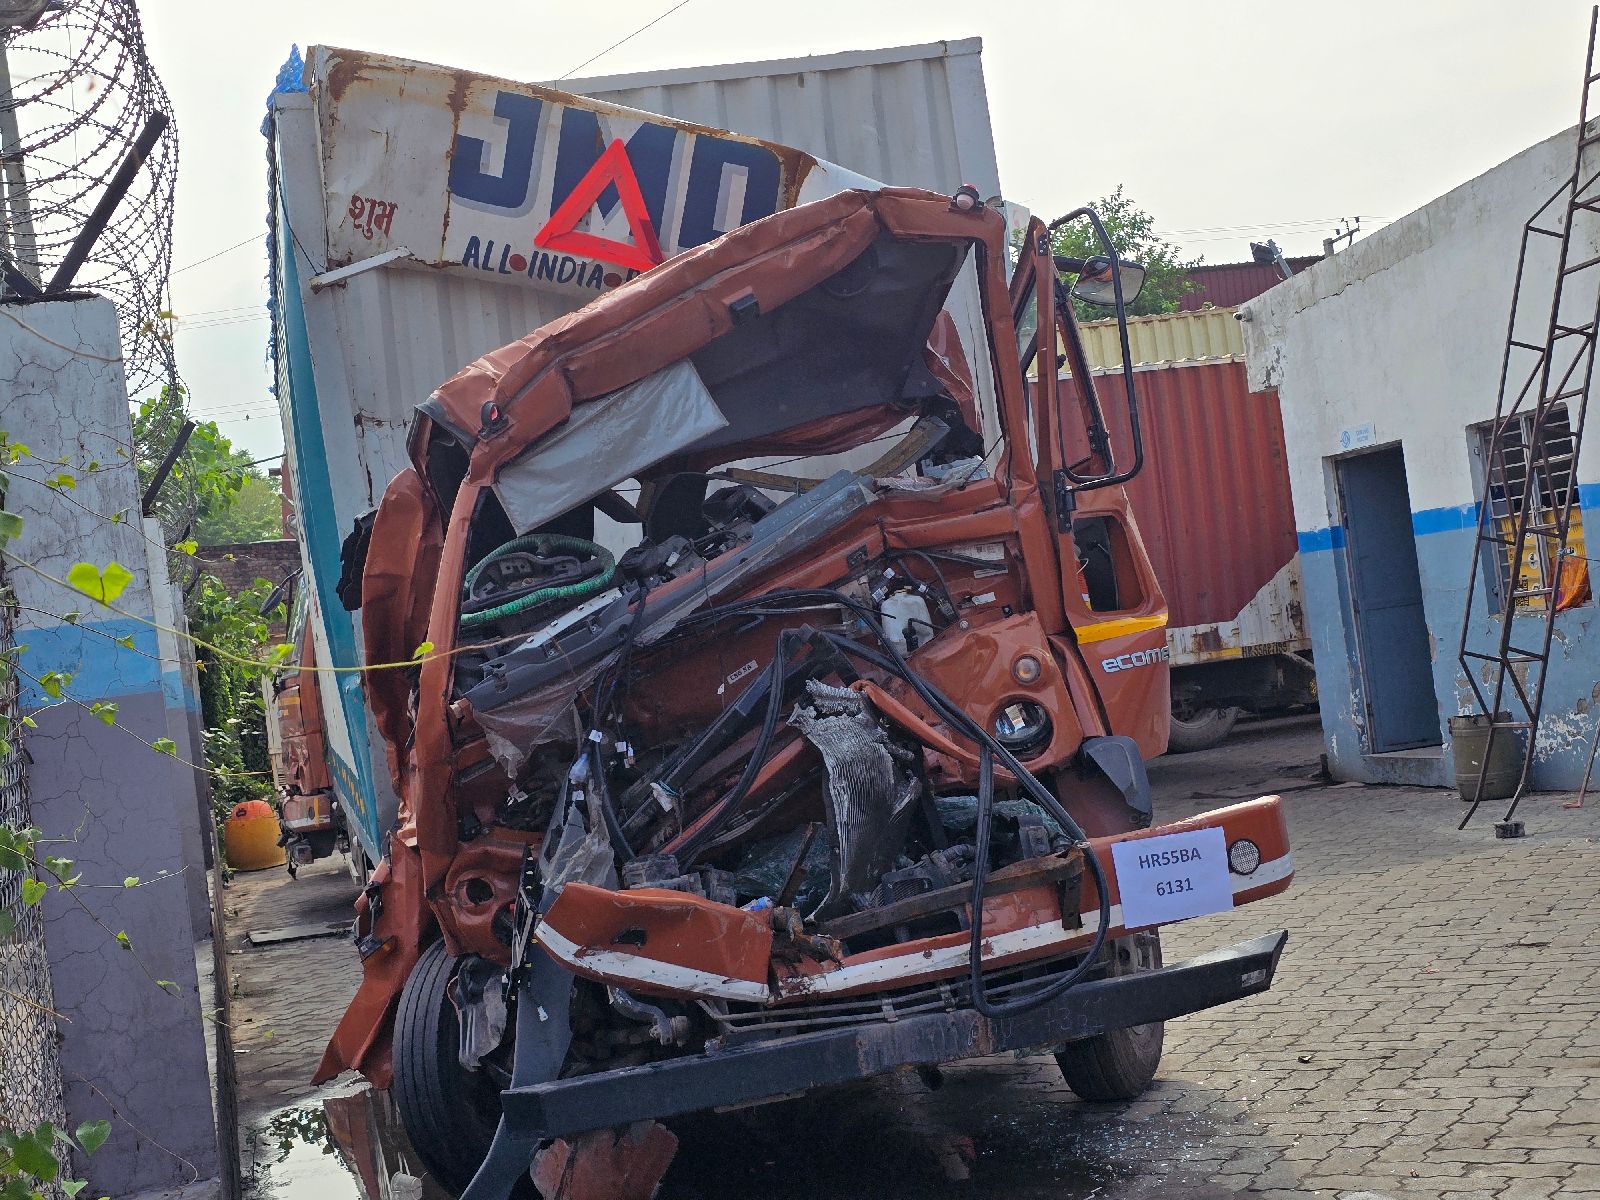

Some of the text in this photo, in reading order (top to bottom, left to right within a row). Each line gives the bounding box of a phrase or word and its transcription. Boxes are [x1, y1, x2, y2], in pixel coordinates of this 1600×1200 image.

[449, 90, 780, 249] JMD
[348, 194, 399, 240] शुभ
[461, 235, 513, 275] ALL
[527, 250, 608, 290] INDIA
[1138, 847, 1202, 869] HR55BA
[1156, 877, 1194, 897] 6131
